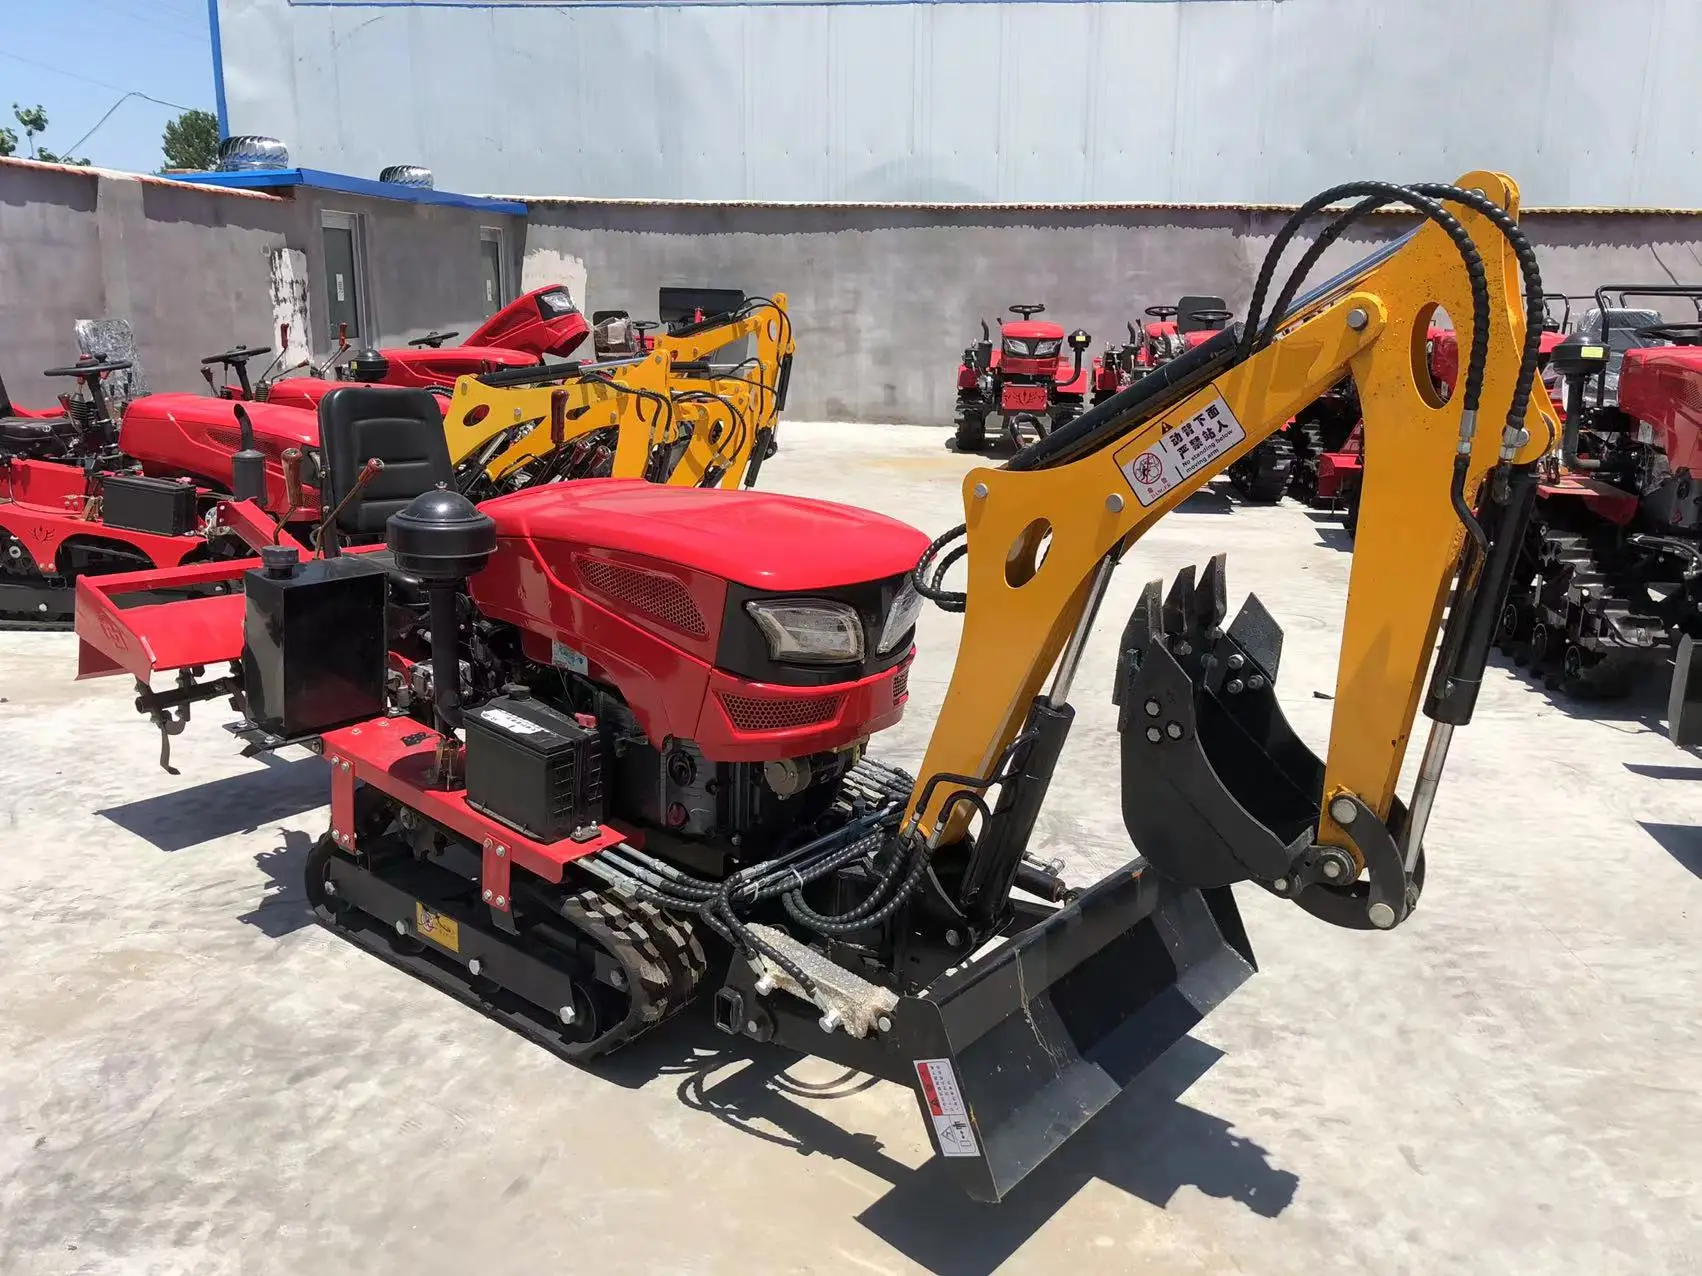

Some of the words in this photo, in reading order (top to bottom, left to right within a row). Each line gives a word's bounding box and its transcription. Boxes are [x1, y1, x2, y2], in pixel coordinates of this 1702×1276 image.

[1168, 404, 1220, 447] 动臂下面
[1176, 420, 1229, 460] 严禁站人
[1182, 459, 1191, 467] No
[1191, 442, 1216, 461] standing
[1215, 429, 1233, 444] below
[1185, 456, 1208, 473] moving
[1207, 448, 1219, 459] arm
